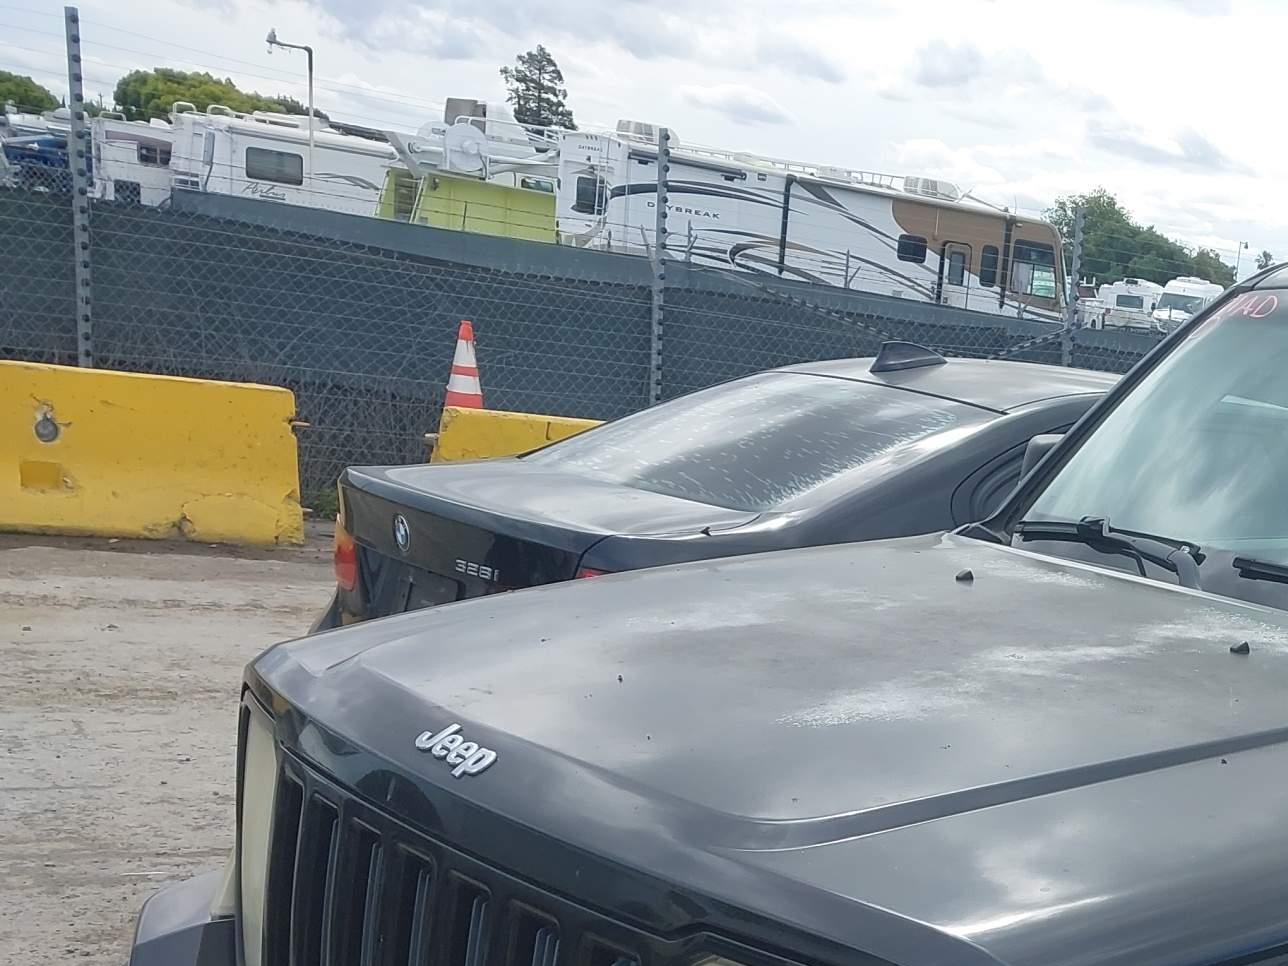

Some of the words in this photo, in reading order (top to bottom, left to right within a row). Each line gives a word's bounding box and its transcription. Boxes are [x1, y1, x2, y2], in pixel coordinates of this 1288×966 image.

[647, 201, 721, 219] DYBREAK
[455, 559, 500, 582] 328i
[414, 723, 499, 778] Jeep
